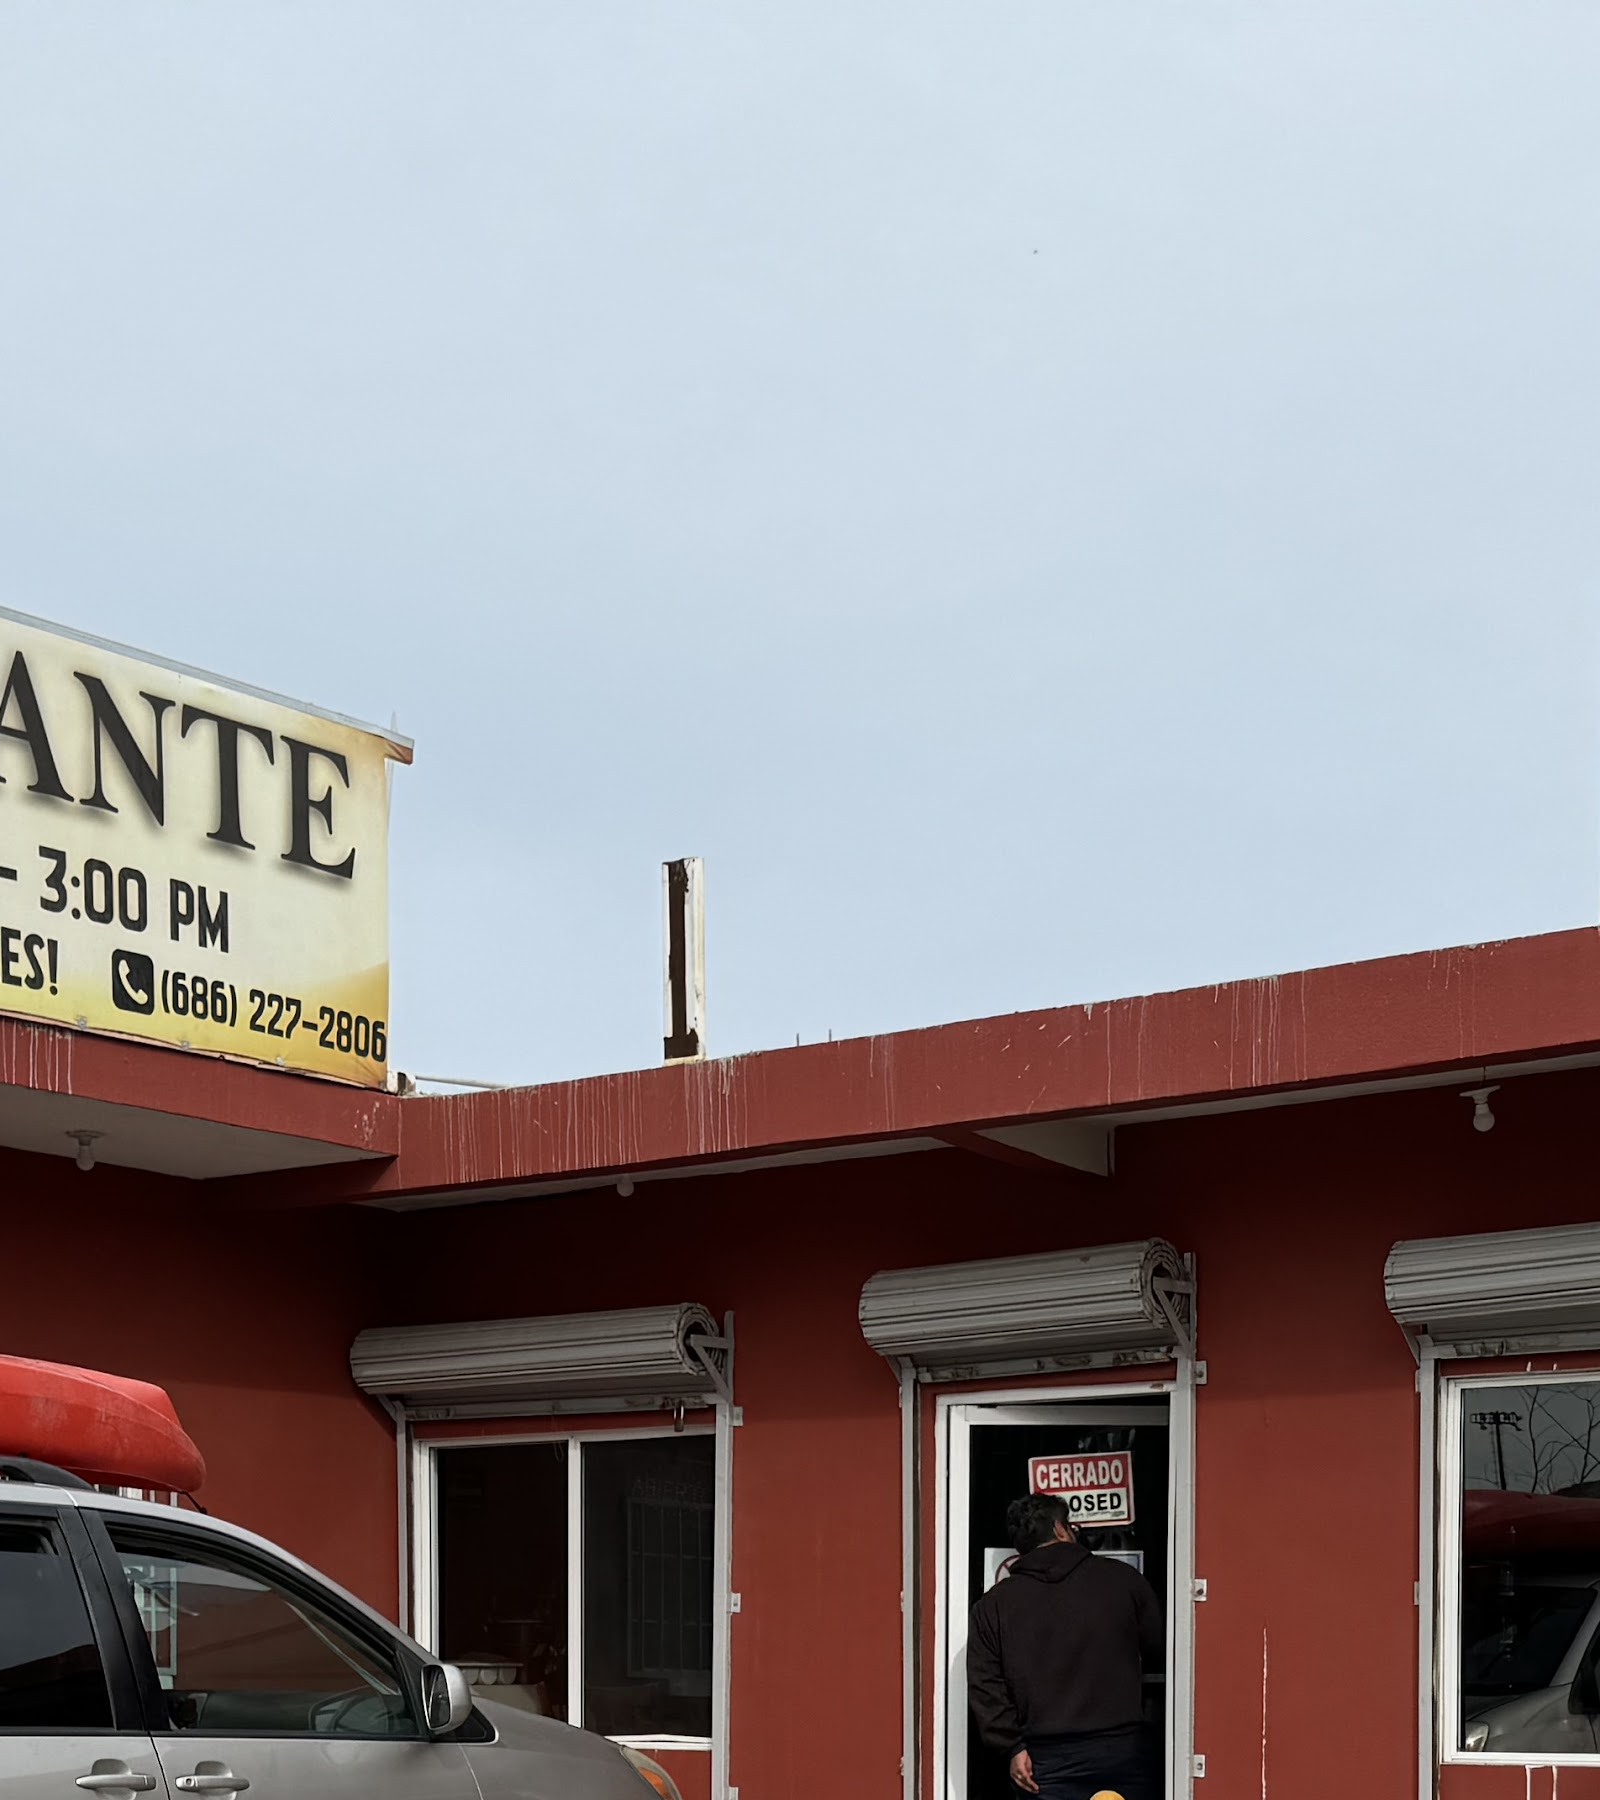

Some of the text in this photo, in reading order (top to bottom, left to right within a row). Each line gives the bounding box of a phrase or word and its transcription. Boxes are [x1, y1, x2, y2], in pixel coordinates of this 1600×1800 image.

[39, 845, 148, 933] 3:00
[169, 878, 229, 953] PM
[161, 968, 387, 1063] (686) 227-2806
[1036, 1459, 1123, 1490] CERRADO
[1069, 1493, 1122, 1512] OSED
